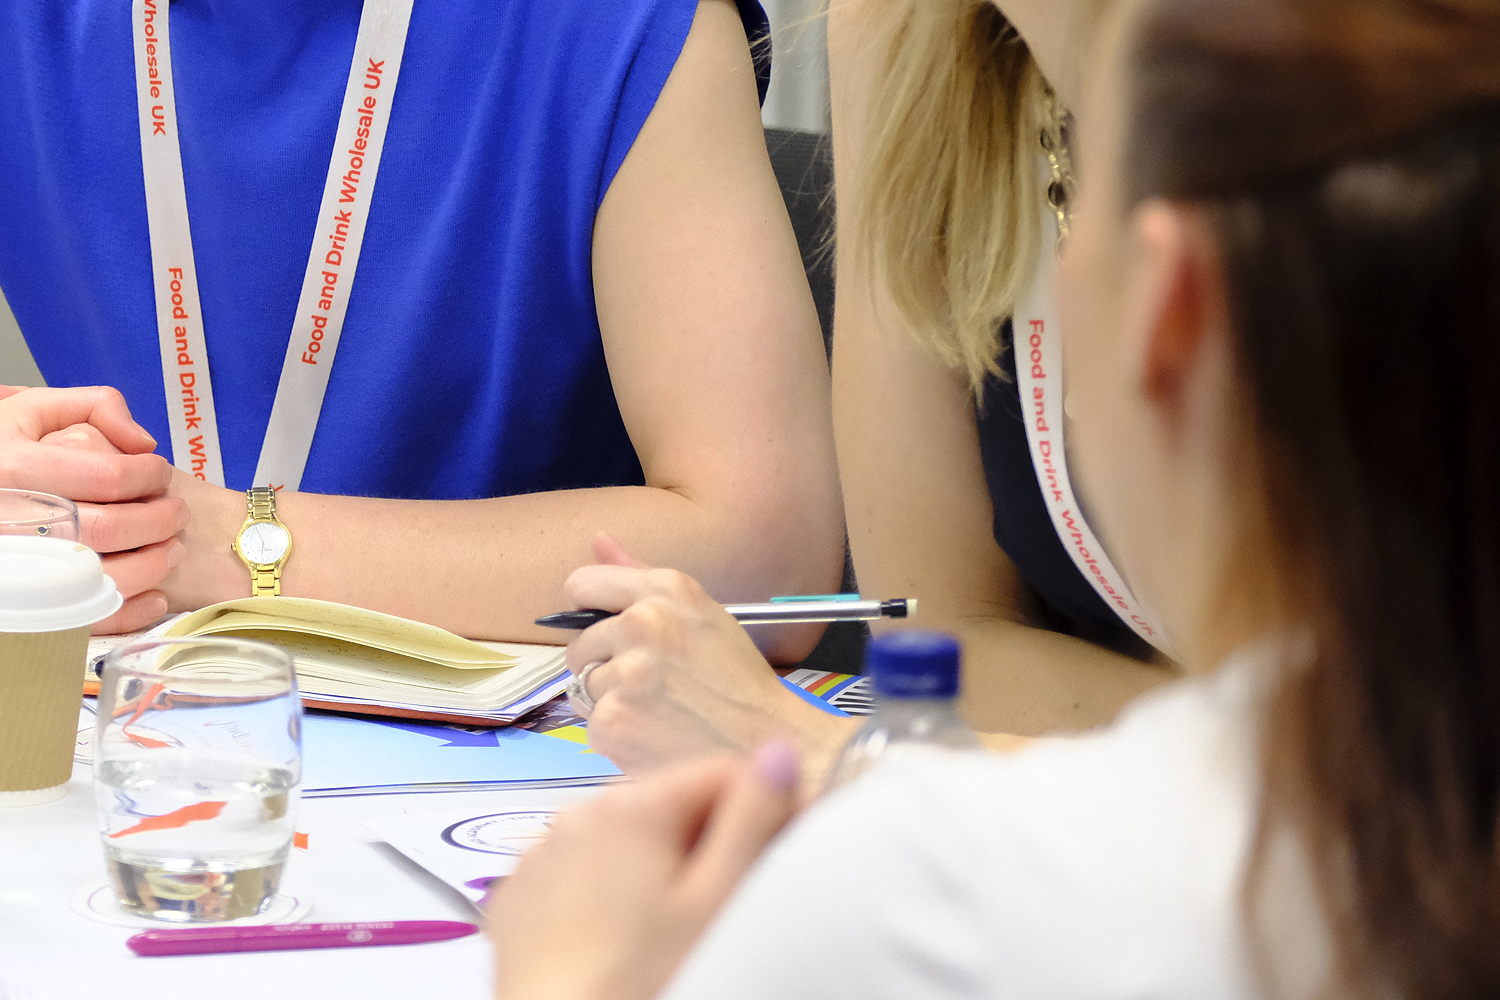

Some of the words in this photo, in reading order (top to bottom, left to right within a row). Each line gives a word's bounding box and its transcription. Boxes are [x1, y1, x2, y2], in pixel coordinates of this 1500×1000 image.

[363, 57, 386, 90] UK
[151, 104, 167, 136] UK
[338, 95, 378, 204] Wholesale
[324, 209, 353, 267] Drink
[167, 266, 189, 320] Food
[317, 269, 339, 312] and
[173, 325, 195, 367] and
[301, 314, 329, 366] Food
[1028, 319, 1047, 380] Food
[178, 371, 203, 431] Drink
[1032, 386, 1050, 433] and
[1038, 439, 1064, 503] Drink
[1061, 509, 1129, 610] Wholesale
[1130, 613, 1159, 638] UK
